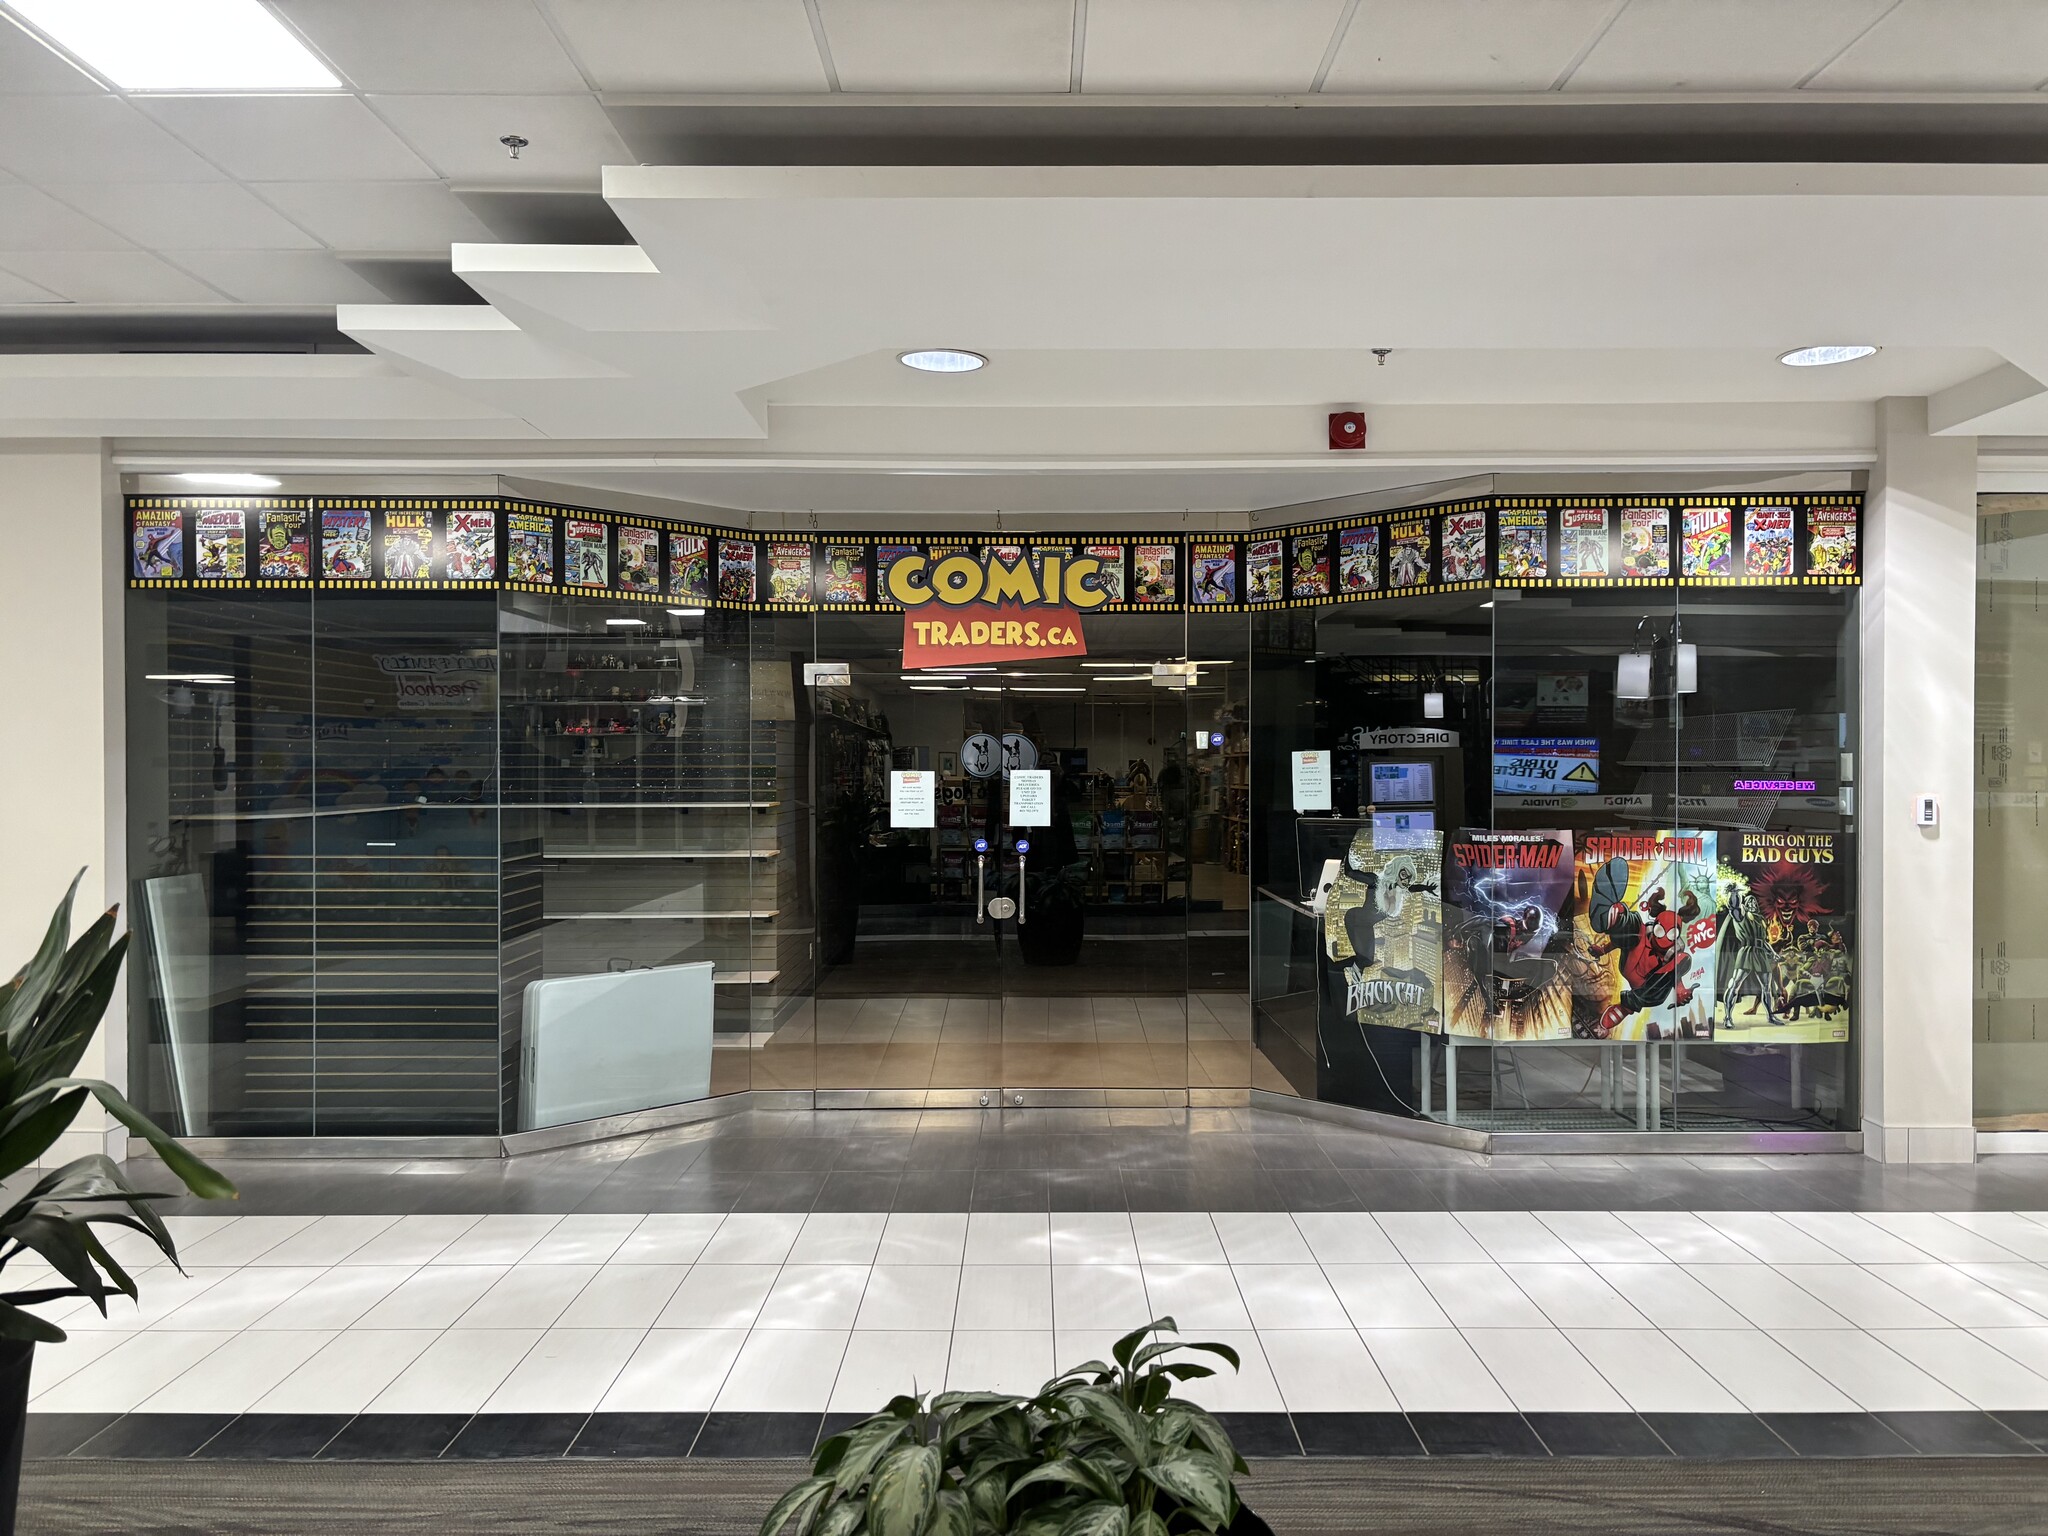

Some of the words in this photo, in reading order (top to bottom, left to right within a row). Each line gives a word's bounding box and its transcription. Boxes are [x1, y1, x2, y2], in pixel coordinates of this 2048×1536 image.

[136, 511, 177, 521] AMAZING
[202, 512, 241, 525] DAREDEVIL
[322, 516, 368, 528] MYSTERY
[386, 515, 425, 528] HULK
[516, 513, 545, 523] CAPTAIN
[1500, 516, 1546, 526] AMERICA
[1564, 510, 1601, 526] SUSPENSE
[1817, 511, 1852, 521] AVENGERS
[508, 520, 551, 533] AMERICA
[568, 520, 602, 537] SUSPENSE
[1690, 511, 1729, 536] HULK
[1391, 524, 1425, 540] HULK
[675, 538, 706, 558] HULK
[776, 547, 807, 557] AVENGERS
[1195, 545, 1230, 554] AMAZING
[886, 551, 1110, 609] COMIC
[912, 620, 1078, 647] TRADERS.CA
[1471, 834, 1498, 842] MILES
[1501, 834, 1544, 842] MORALES:
[1743, 834, 1784, 847] BRING
[1787, 834, 1805, 847] ON
[1808, 834, 1833, 847] THE
[1453, 843, 1564, 869] SPIDER-MAN
[1741, 847, 1781, 863] BAD
[1784, 848, 1835, 864] GUYS
[1693, 928, 1715, 944] NYC
[1346, 981, 1394, 1016] BLACK
[1395, 981, 1425, 1006] CAT
